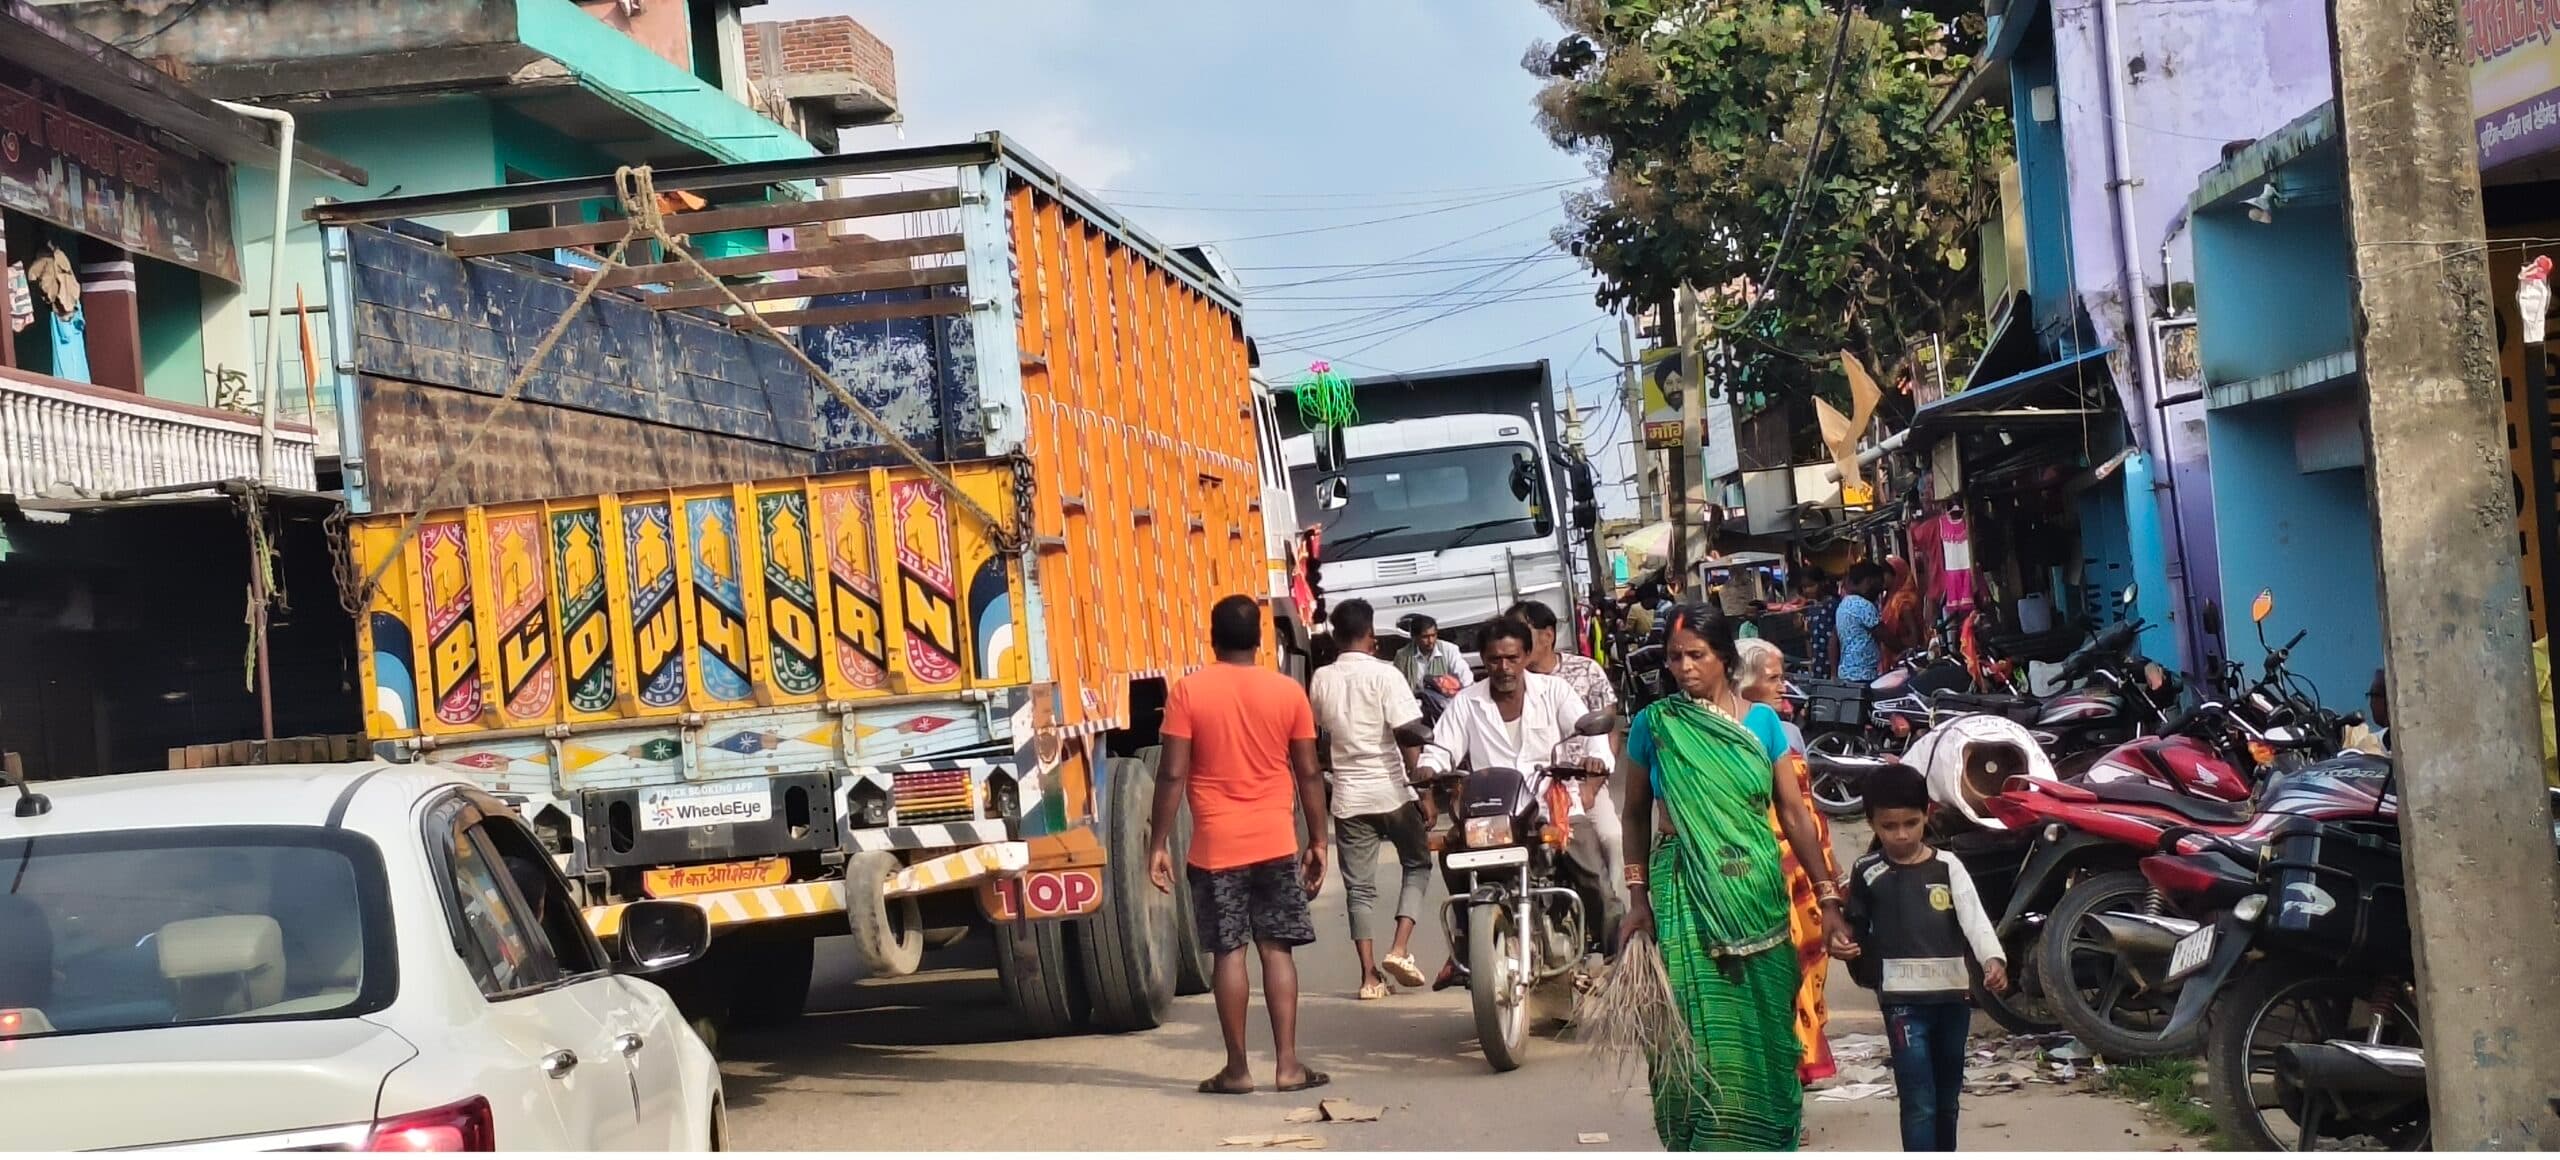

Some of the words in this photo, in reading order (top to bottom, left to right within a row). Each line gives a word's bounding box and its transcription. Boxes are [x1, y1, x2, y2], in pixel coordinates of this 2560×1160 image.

[1393, 593, 1425, 604] TATA
[688, 784, 733, 797] BOOKING
[735, 781, 753, 793] APP
[676, 800, 761, 819] WheelsEye
[686, 873, 707, 887] का
[993, 871, 1098, 917] TOP
